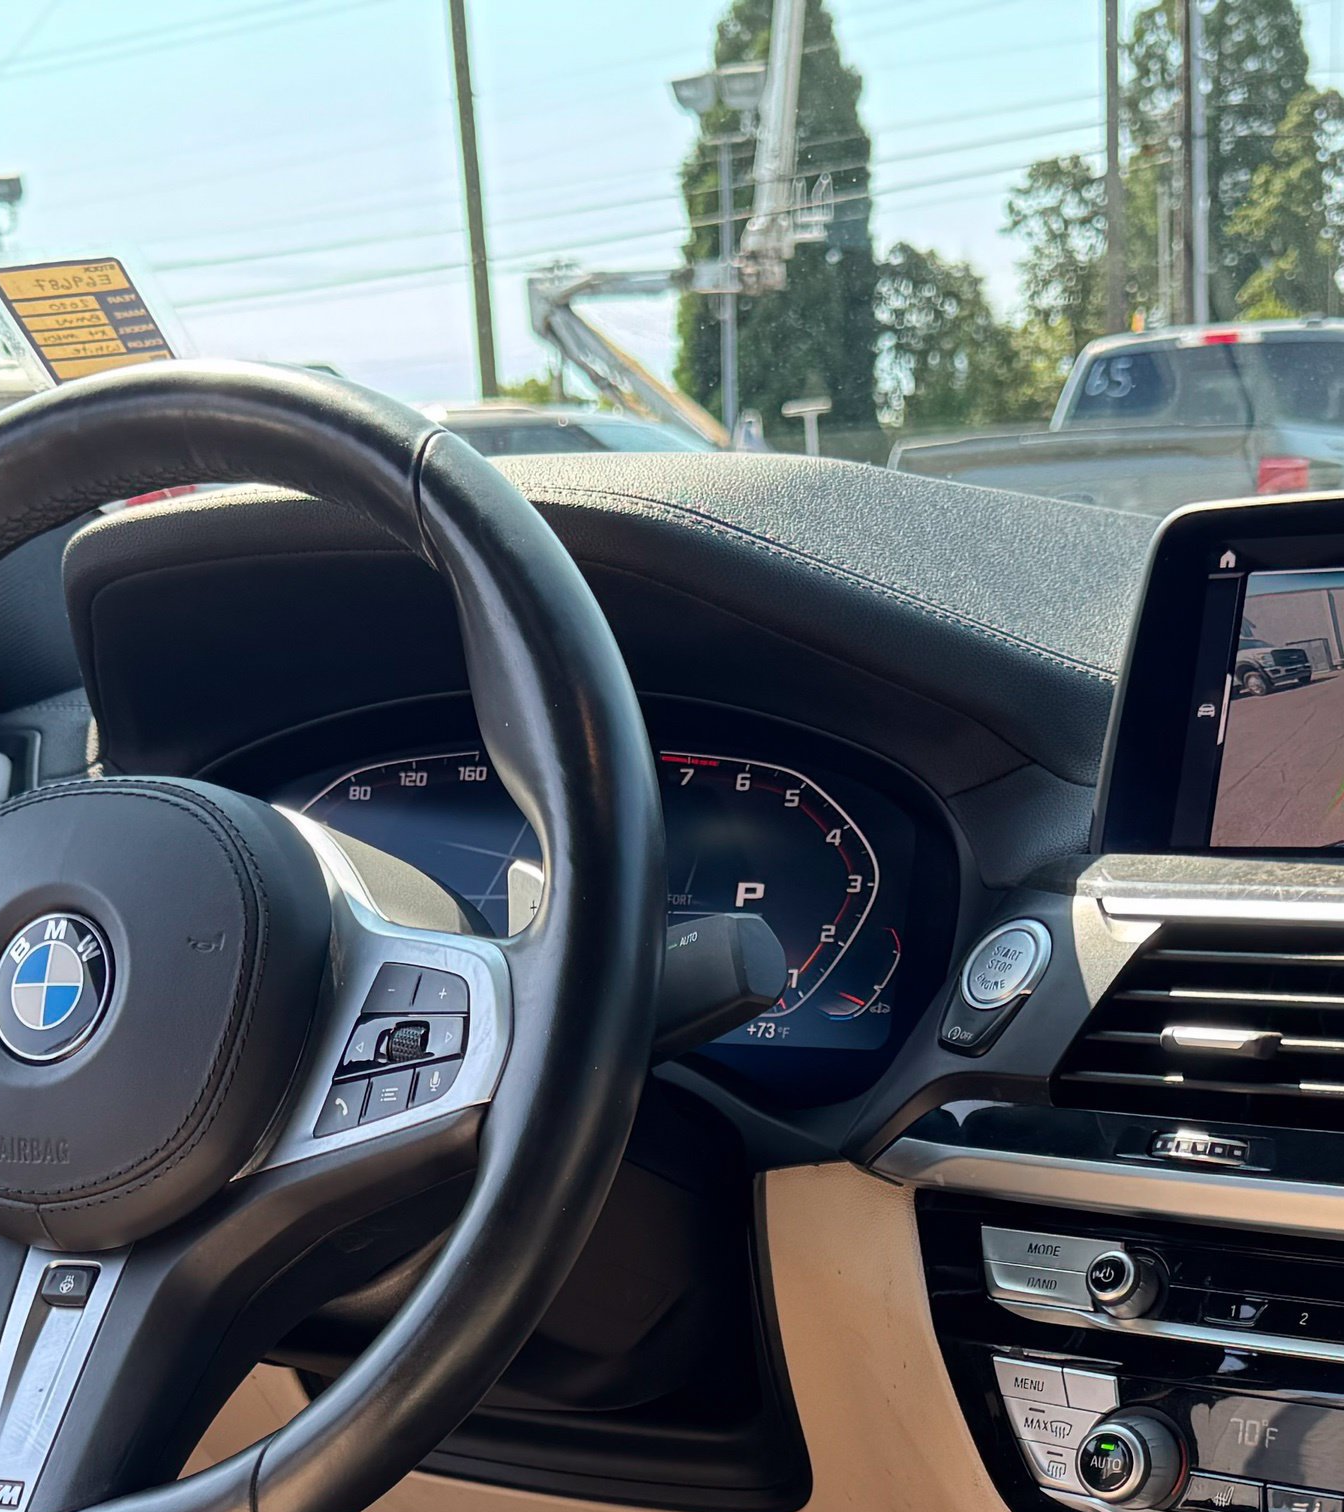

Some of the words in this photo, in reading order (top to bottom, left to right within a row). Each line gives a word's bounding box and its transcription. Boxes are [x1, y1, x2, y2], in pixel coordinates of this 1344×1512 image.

[398, 772, 428, 787] 120
[458, 767, 488, 782] 160
[680, 768, 695, 786] 7
[735, 773, 751, 792] 6
[349, 786, 372, 801] 80
[784, 789, 801, 808] 5
[825, 828, 842, 847] 4
[846, 875, 863, 893] 3
[666, 894, 694, 906] FORT
[735, 882, 766, 908] P
[679, 931, 698, 948] AUTO
[820, 924, 836, 943] 2
[9, 919, 102, 966] BMW
[992, 945, 1024, 962] START
[987, 958, 1012, 973] STOP
[787, 968, 799, 989] 1
[975, 972, 1006, 991] ENGINE
[746, 1022, 776, 1039] +73
[959, 1031, 974, 1041] OFF
[1027, 1242, 1062, 1257] MODE
[1228, 1303, 1238, 1318] 1
[1298, 1311, 1309, 1327] 2
[1013, 1376, 1046, 1393] MENU
[1023, 1416, 1050, 1433] MAX
[1089, 1454, 1123, 1473] AUTO
